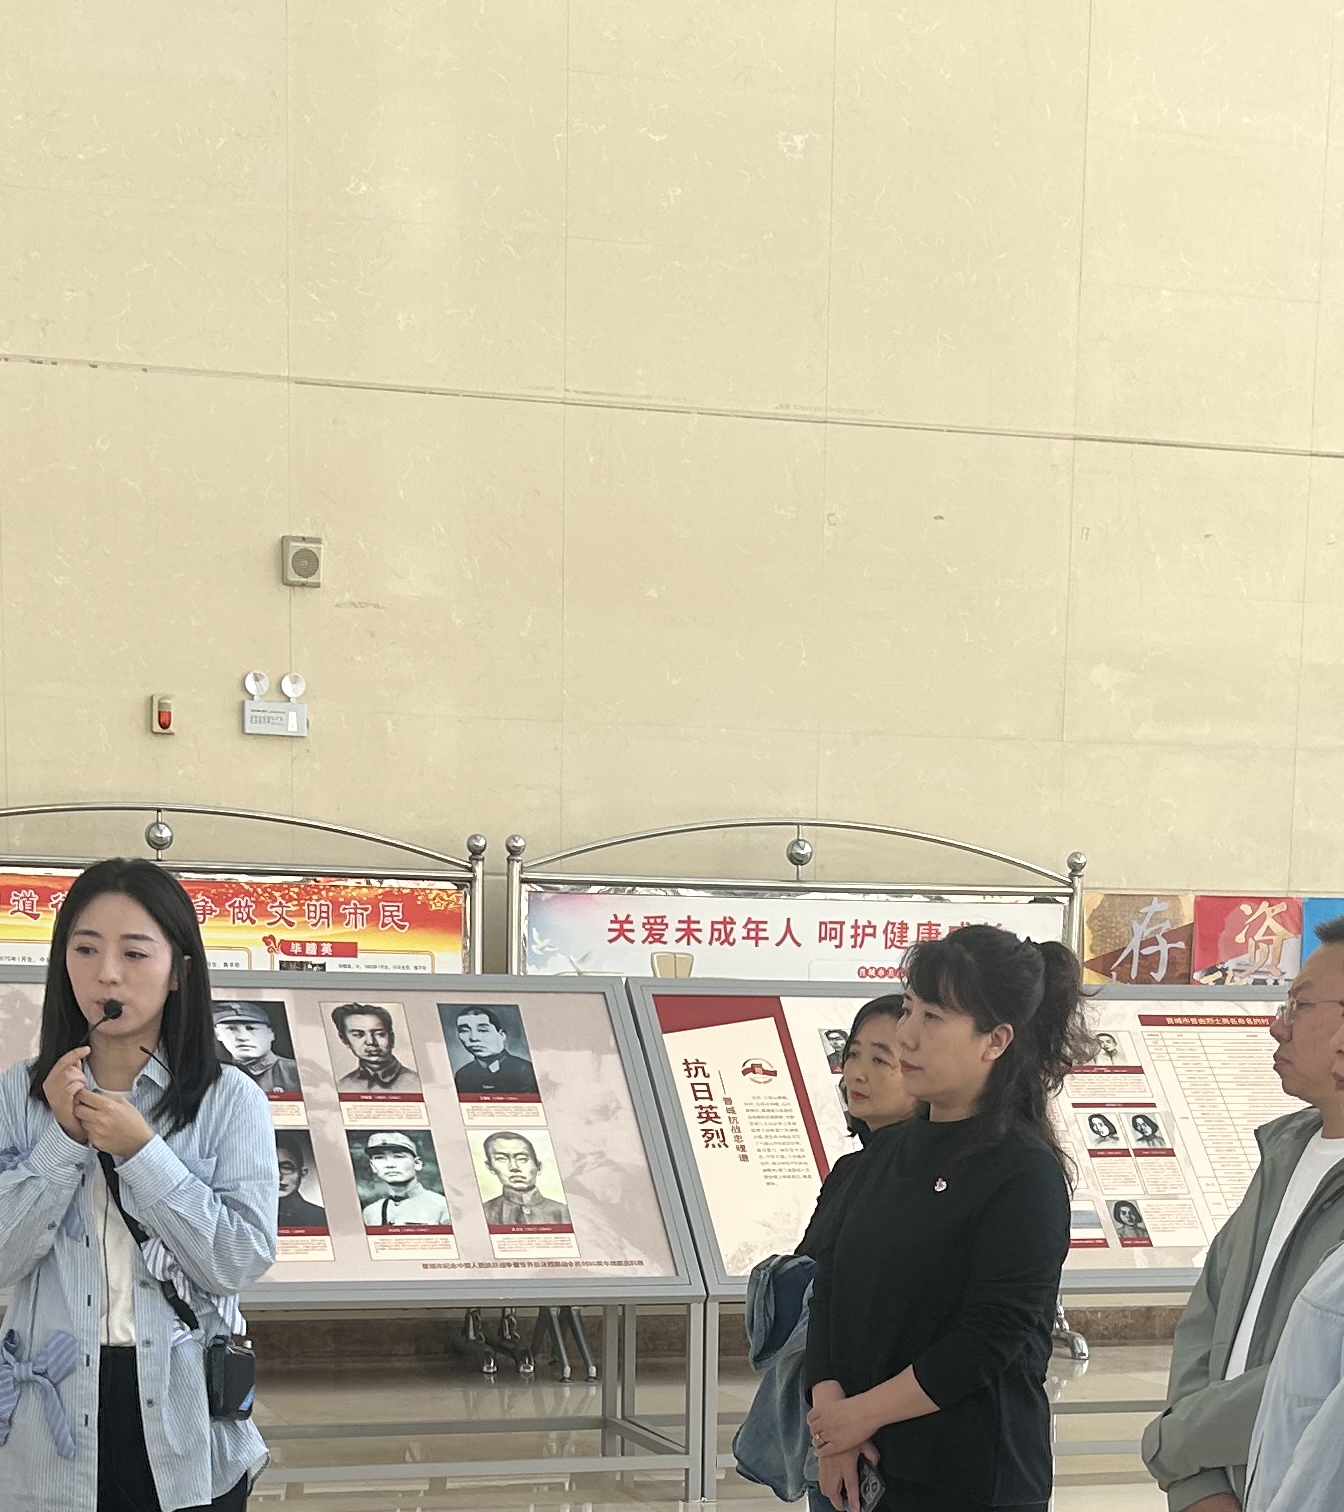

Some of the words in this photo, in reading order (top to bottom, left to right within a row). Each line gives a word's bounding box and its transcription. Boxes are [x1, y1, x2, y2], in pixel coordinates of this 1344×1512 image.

[606, 914, 804, 949] 关爱未成年人
[818, 920, 1004, 950] 呵护健康
[1109, 896, 1187, 983] 存
[681, 1058, 730, 1149] 抗日英烈
